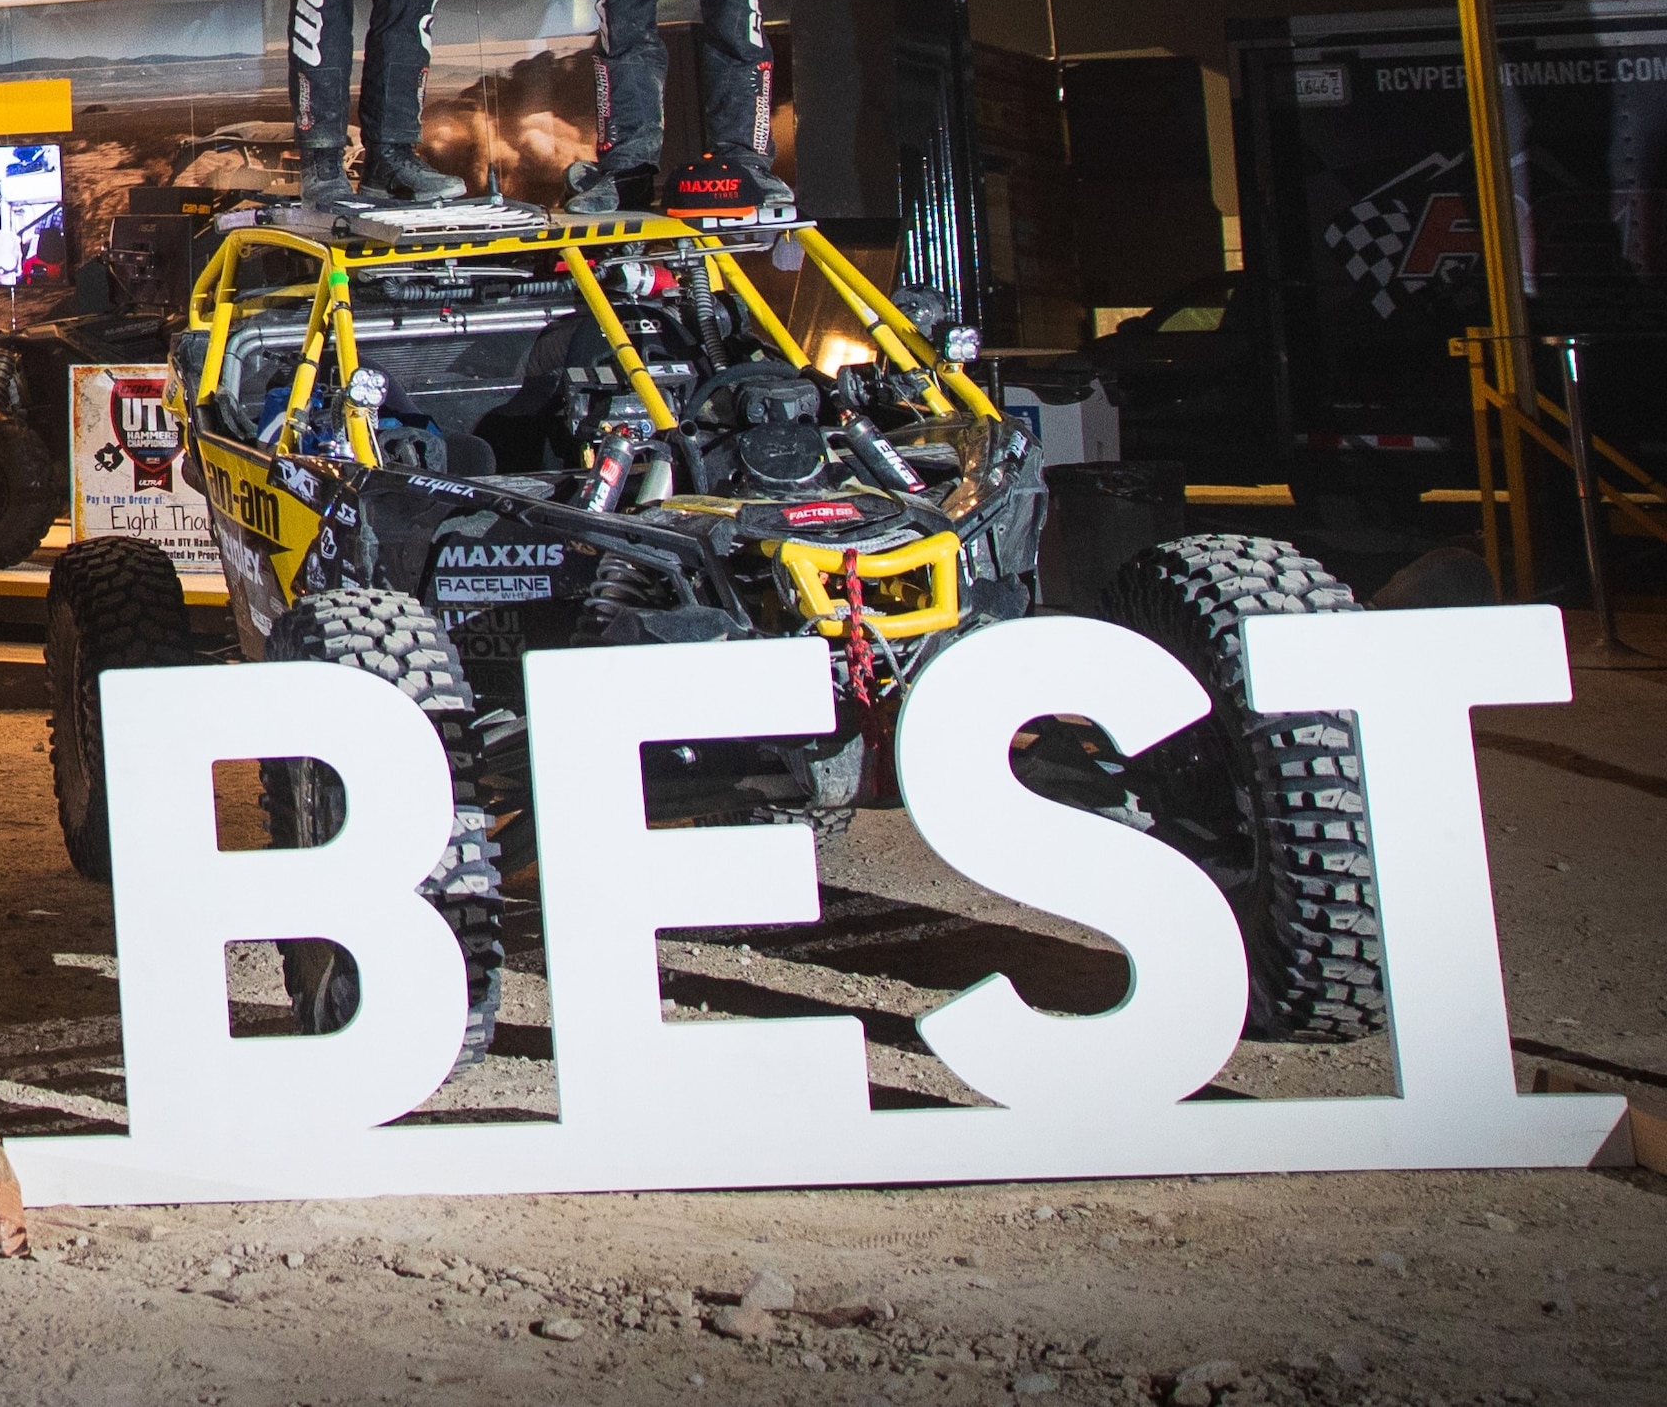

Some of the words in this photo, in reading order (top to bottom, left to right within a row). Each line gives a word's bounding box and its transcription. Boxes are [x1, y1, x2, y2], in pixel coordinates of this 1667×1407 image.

[678, 178, 741, 194] MAXXIS
[126, 431, 179, 441] HAMMERS
[126, 439, 179, 449] CHAMPIONSHIP
[86, 494, 101, 506] Pay
[103, 495, 112, 505] to
[114, 495, 125, 505] the
[128, 495, 153, 505] Order
[208, 470, 280, 544] an-am
[110, 505, 160, 537] Eight
[789, 507, 835, 521] FACTOR
[835, 507, 854, 516] 55
[177, 537, 192, 547] UTV
[436, 542, 565, 569] MAXXIS
[438, 576, 549, 593] RACELINE
[463, 635, 527, 658] OLY
[98, 603, 1575, 1139] BEST
